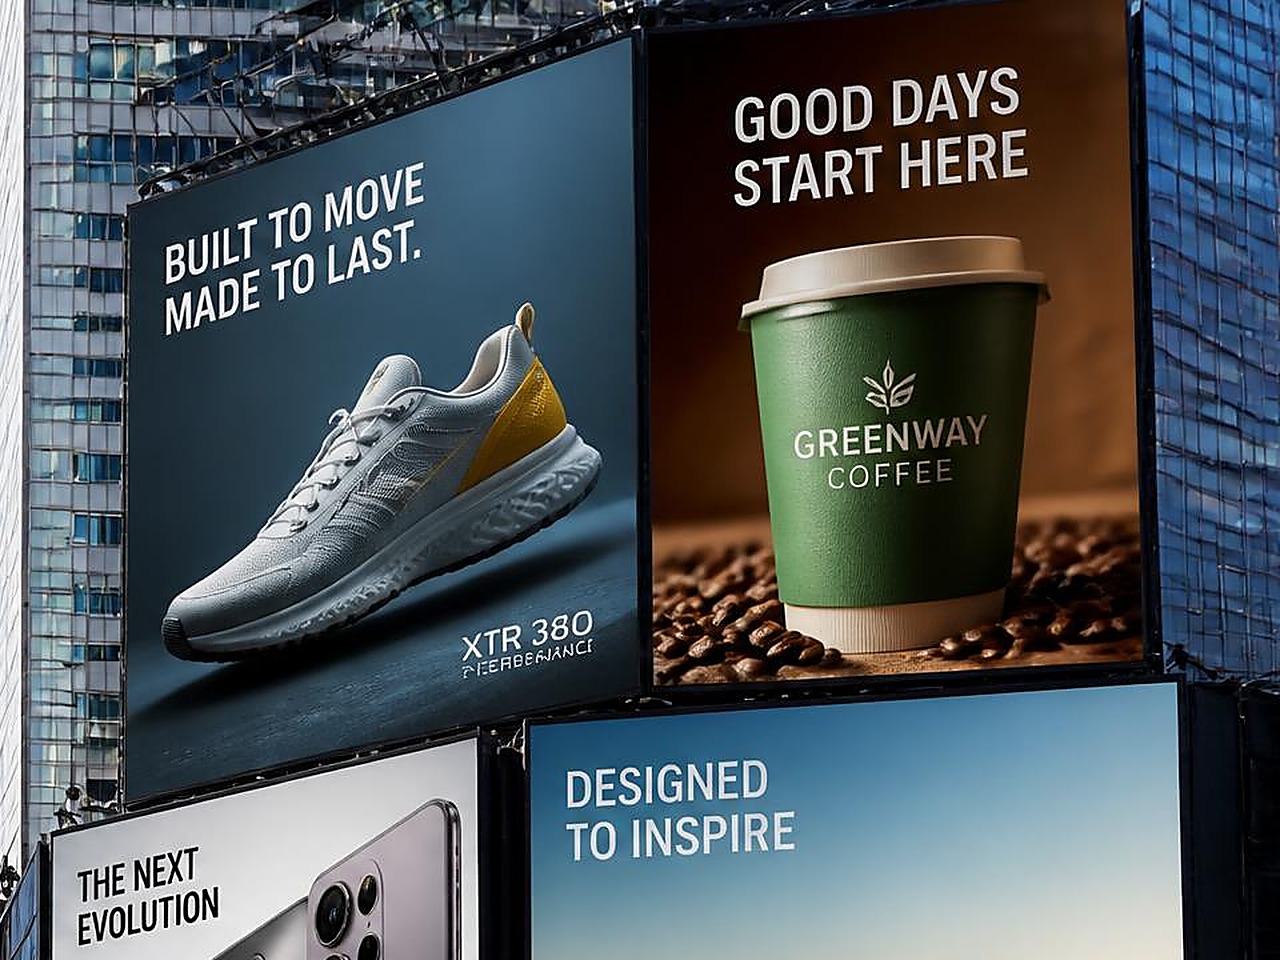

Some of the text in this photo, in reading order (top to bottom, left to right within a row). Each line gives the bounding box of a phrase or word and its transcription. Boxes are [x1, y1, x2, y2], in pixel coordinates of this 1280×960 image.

[734, 67, 1020, 144] GOOD DAYS
[733, 128, 1029, 207] START HERE
[165, 161, 425, 286] BUILT TO MOVE
[165, 219, 422, 336] MADE TO LAST.
[793, 415, 988, 460] GREENWAY
[827, 458, 953, 490] COFFEE
[461, 610, 593, 662] XTR 380
[566, 759, 768, 809] DESIGNED
[565, 810, 796, 862] TO INSPIRE
[77, 846, 199, 903] THE NEXT
[78, 886, 219, 946] EVOLUTION
